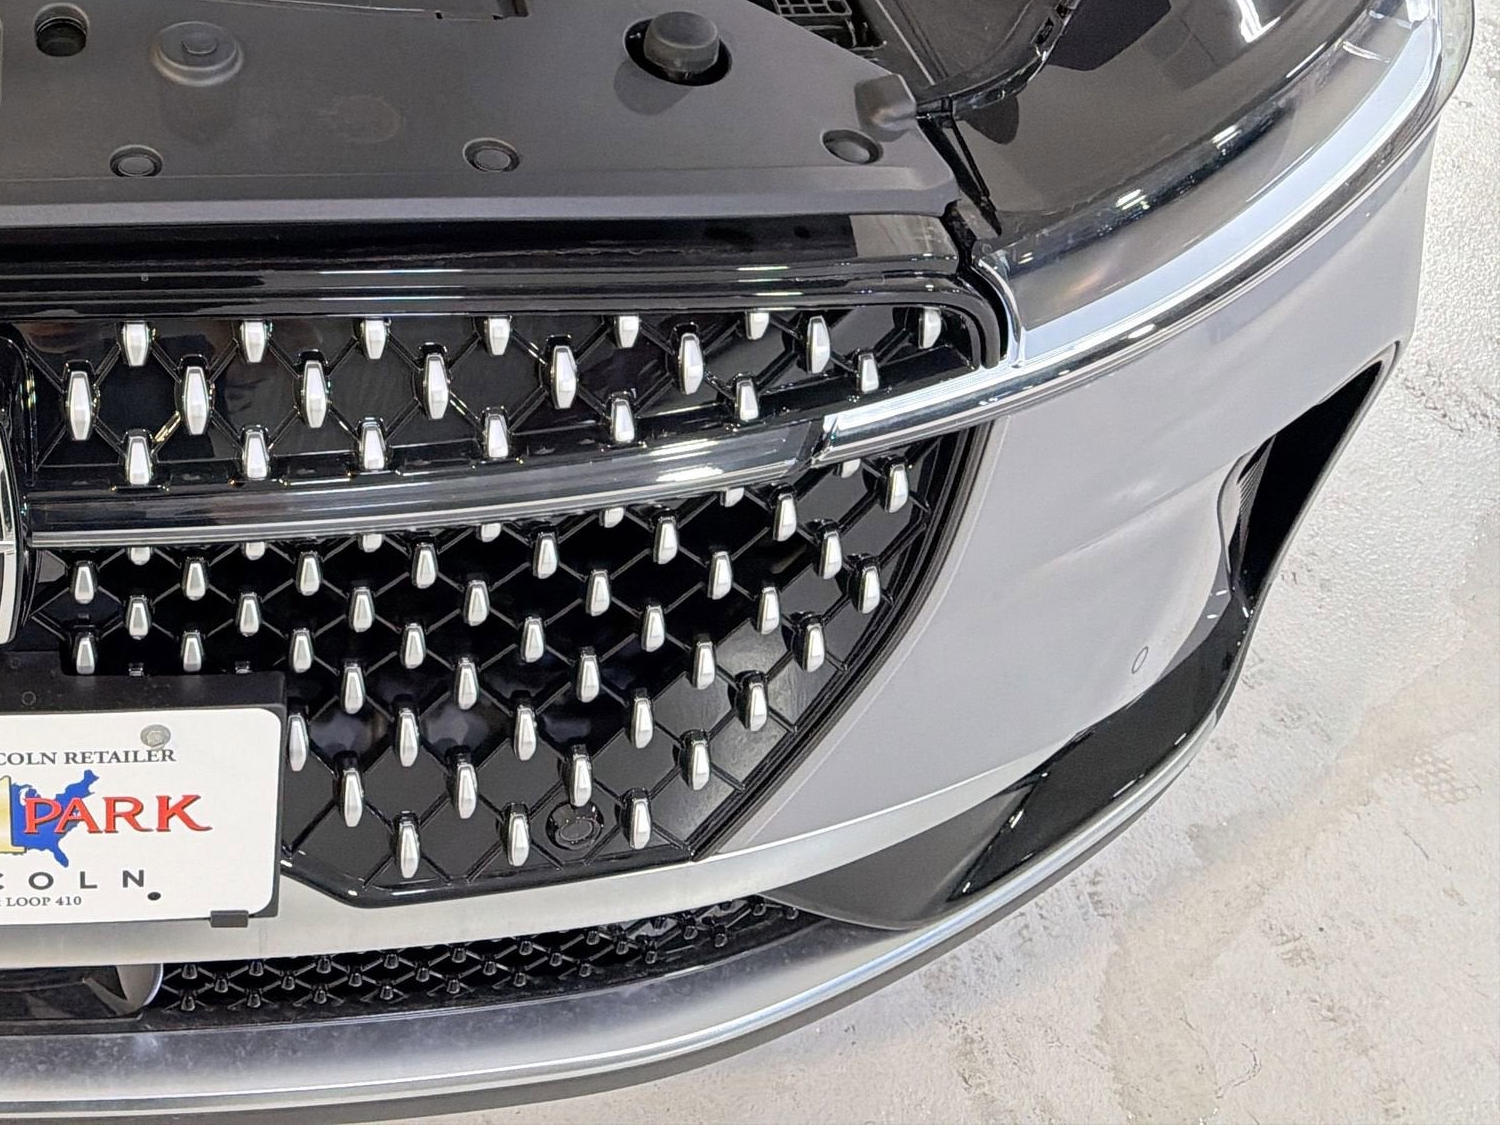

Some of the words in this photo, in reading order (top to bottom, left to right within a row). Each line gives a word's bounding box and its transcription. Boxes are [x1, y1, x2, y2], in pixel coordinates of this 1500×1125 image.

[63, 748, 177, 765] RETAILER
[23, 793, 213, 835] PARK
[6, 895, 52, 907] LOOP
[55, 895, 82, 906] 410
